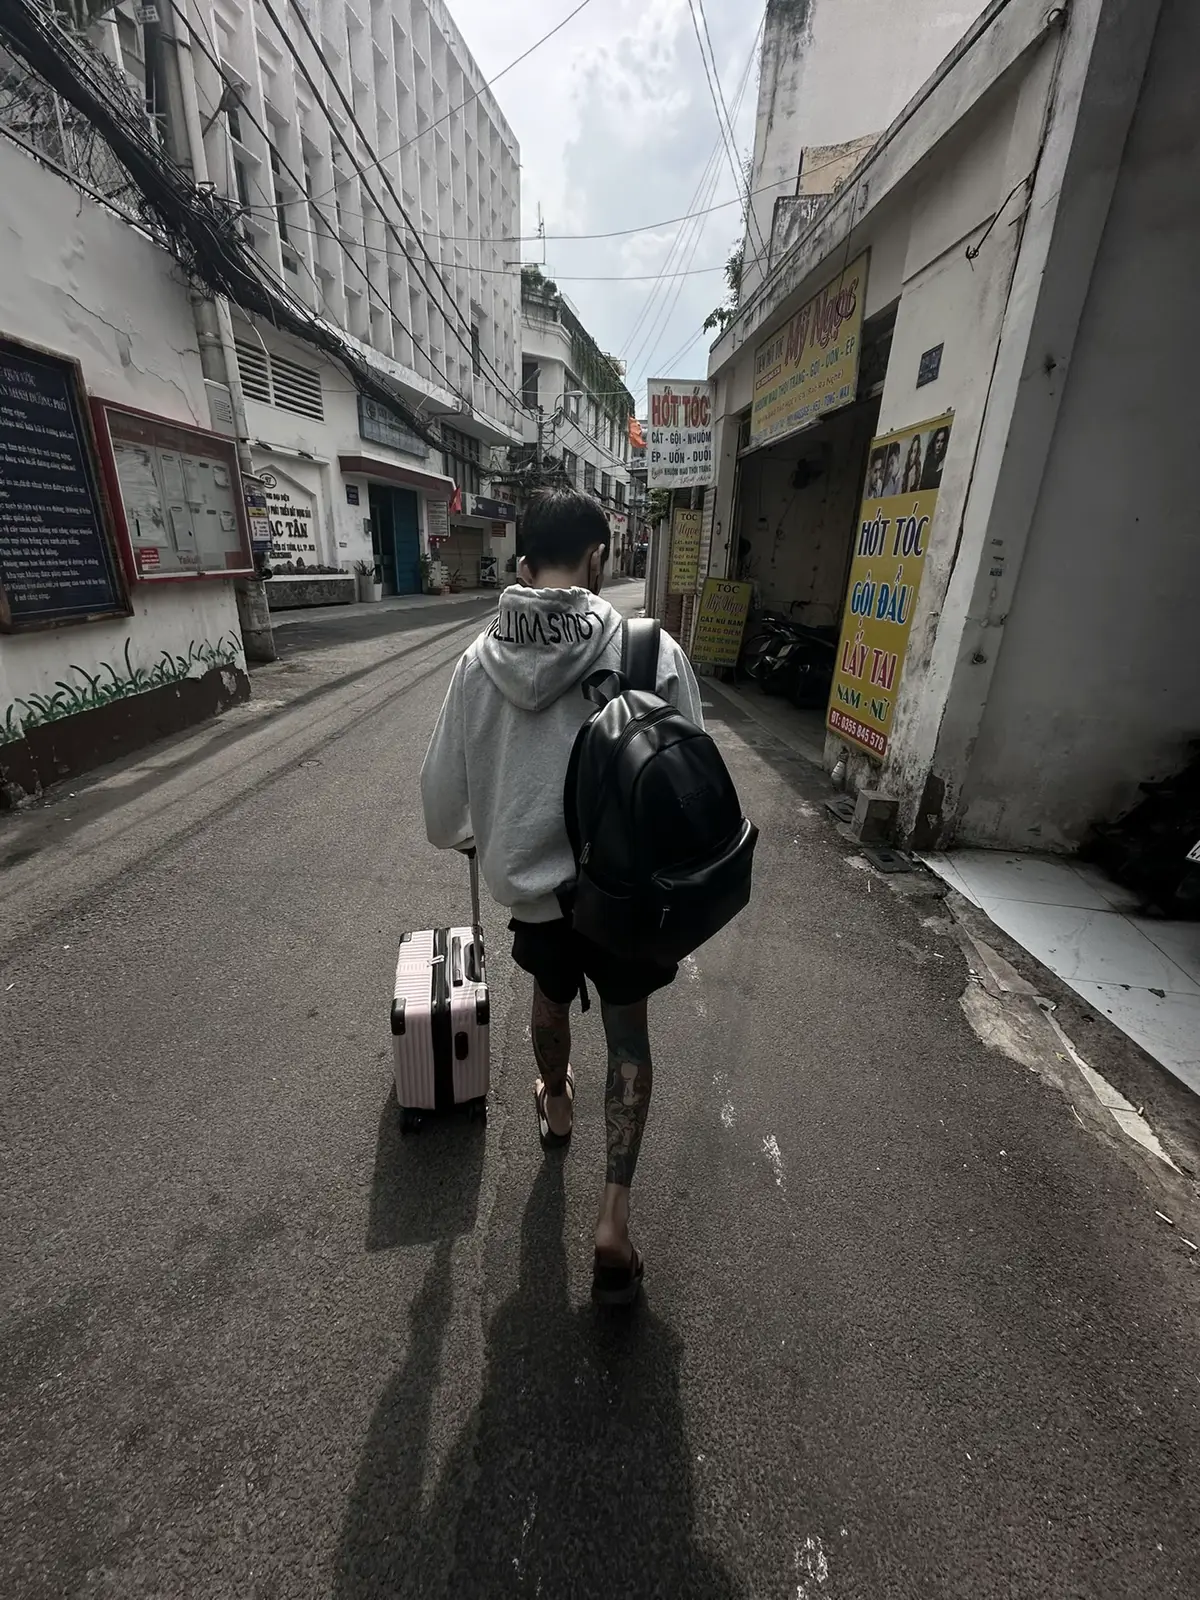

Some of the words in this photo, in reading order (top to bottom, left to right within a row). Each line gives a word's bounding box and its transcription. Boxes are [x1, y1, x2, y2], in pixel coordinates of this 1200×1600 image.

[286, 519, 308, 538] TÂN
[681, 512, 698, 521] TÓC
[857, 507, 891, 557] HỚT
[892, 502, 929, 557] TÓC
[717, 583, 740, 594] TÓC
[870, 648, 898, 691] TAI
[837, 684, 862, 709] NAM
[870, 697, 891, 722] NỮ
